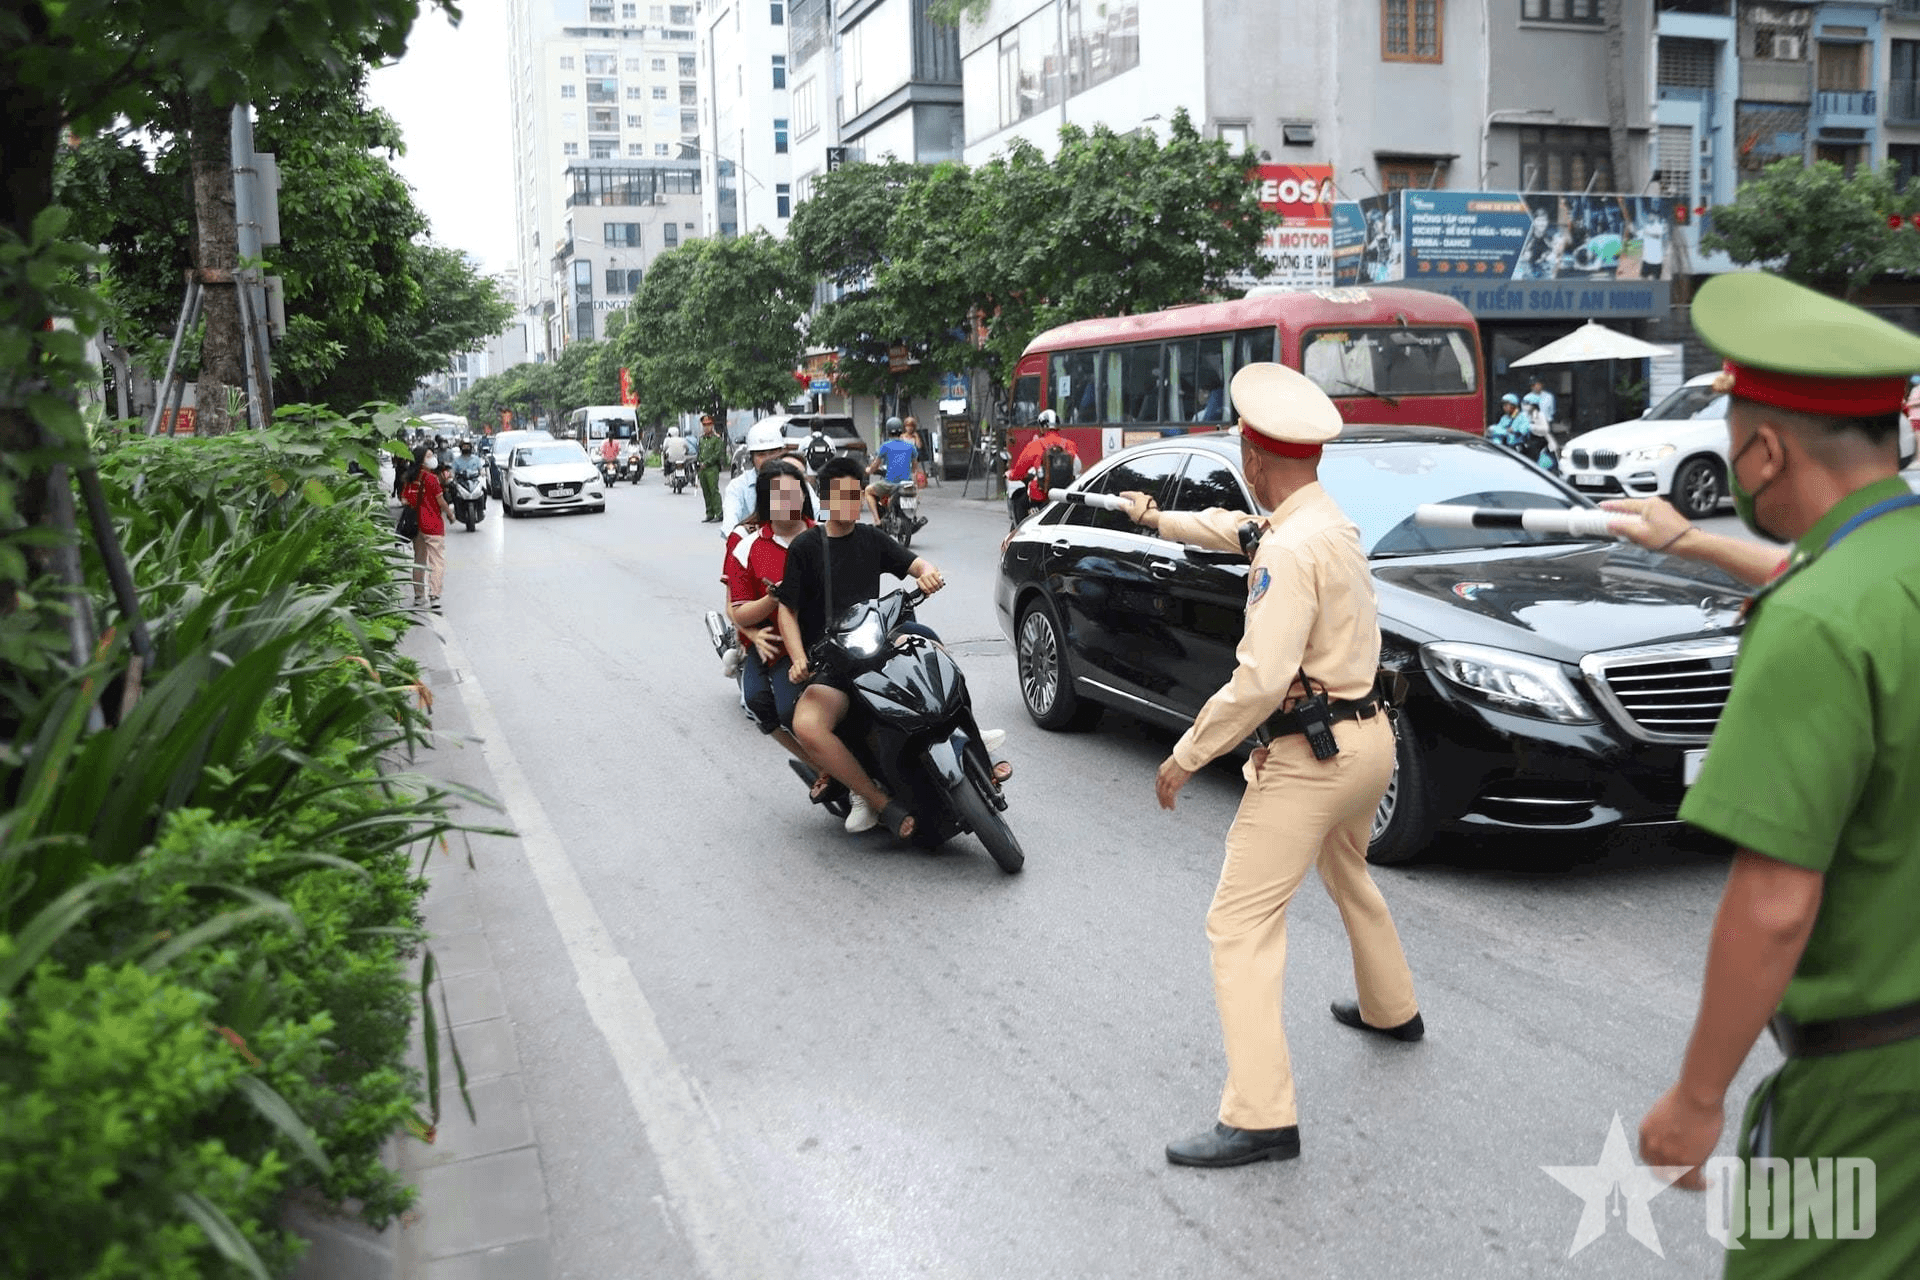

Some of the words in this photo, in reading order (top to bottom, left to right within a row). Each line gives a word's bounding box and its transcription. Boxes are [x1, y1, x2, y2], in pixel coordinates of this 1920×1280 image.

[1279, 233, 1329, 249] MOTOR
[1443, 238, 1471, 248] DANCE
[1303, 255, 1313, 270] XE
[1529, 286, 1573, 310] SOÁT
[1579, 290, 1604, 310] AN
